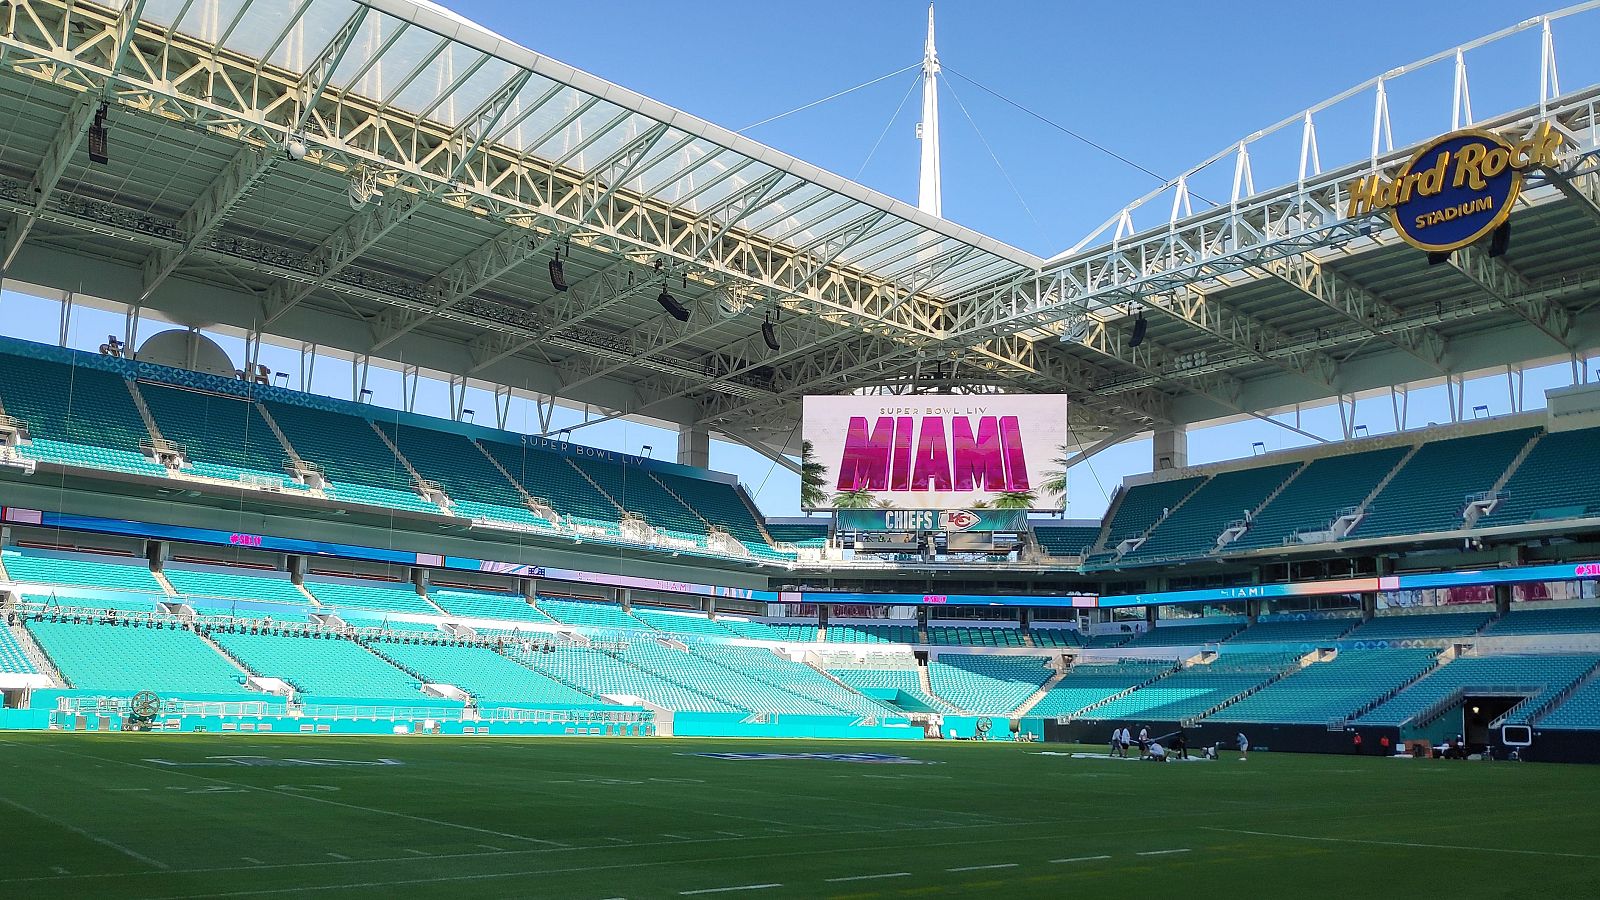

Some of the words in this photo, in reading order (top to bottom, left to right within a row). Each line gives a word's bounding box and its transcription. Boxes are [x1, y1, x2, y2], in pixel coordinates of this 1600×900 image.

[1346, 151, 1450, 219] Hard
[1453, 120, 1563, 191] Rock
[1415, 195, 1493, 229] STADIUM
[880, 407, 919, 415] SUPER
[926, 407, 960, 415] BOWL
[966, 407, 988, 415] LIV
[521, 434, 569, 452] SUPER
[576, 446, 614, 461] BOWL
[622, 455, 644, 466] LIV
[836, 415, 1030, 492] MIAMI
[885, 510, 933, 530] CHIEFS
